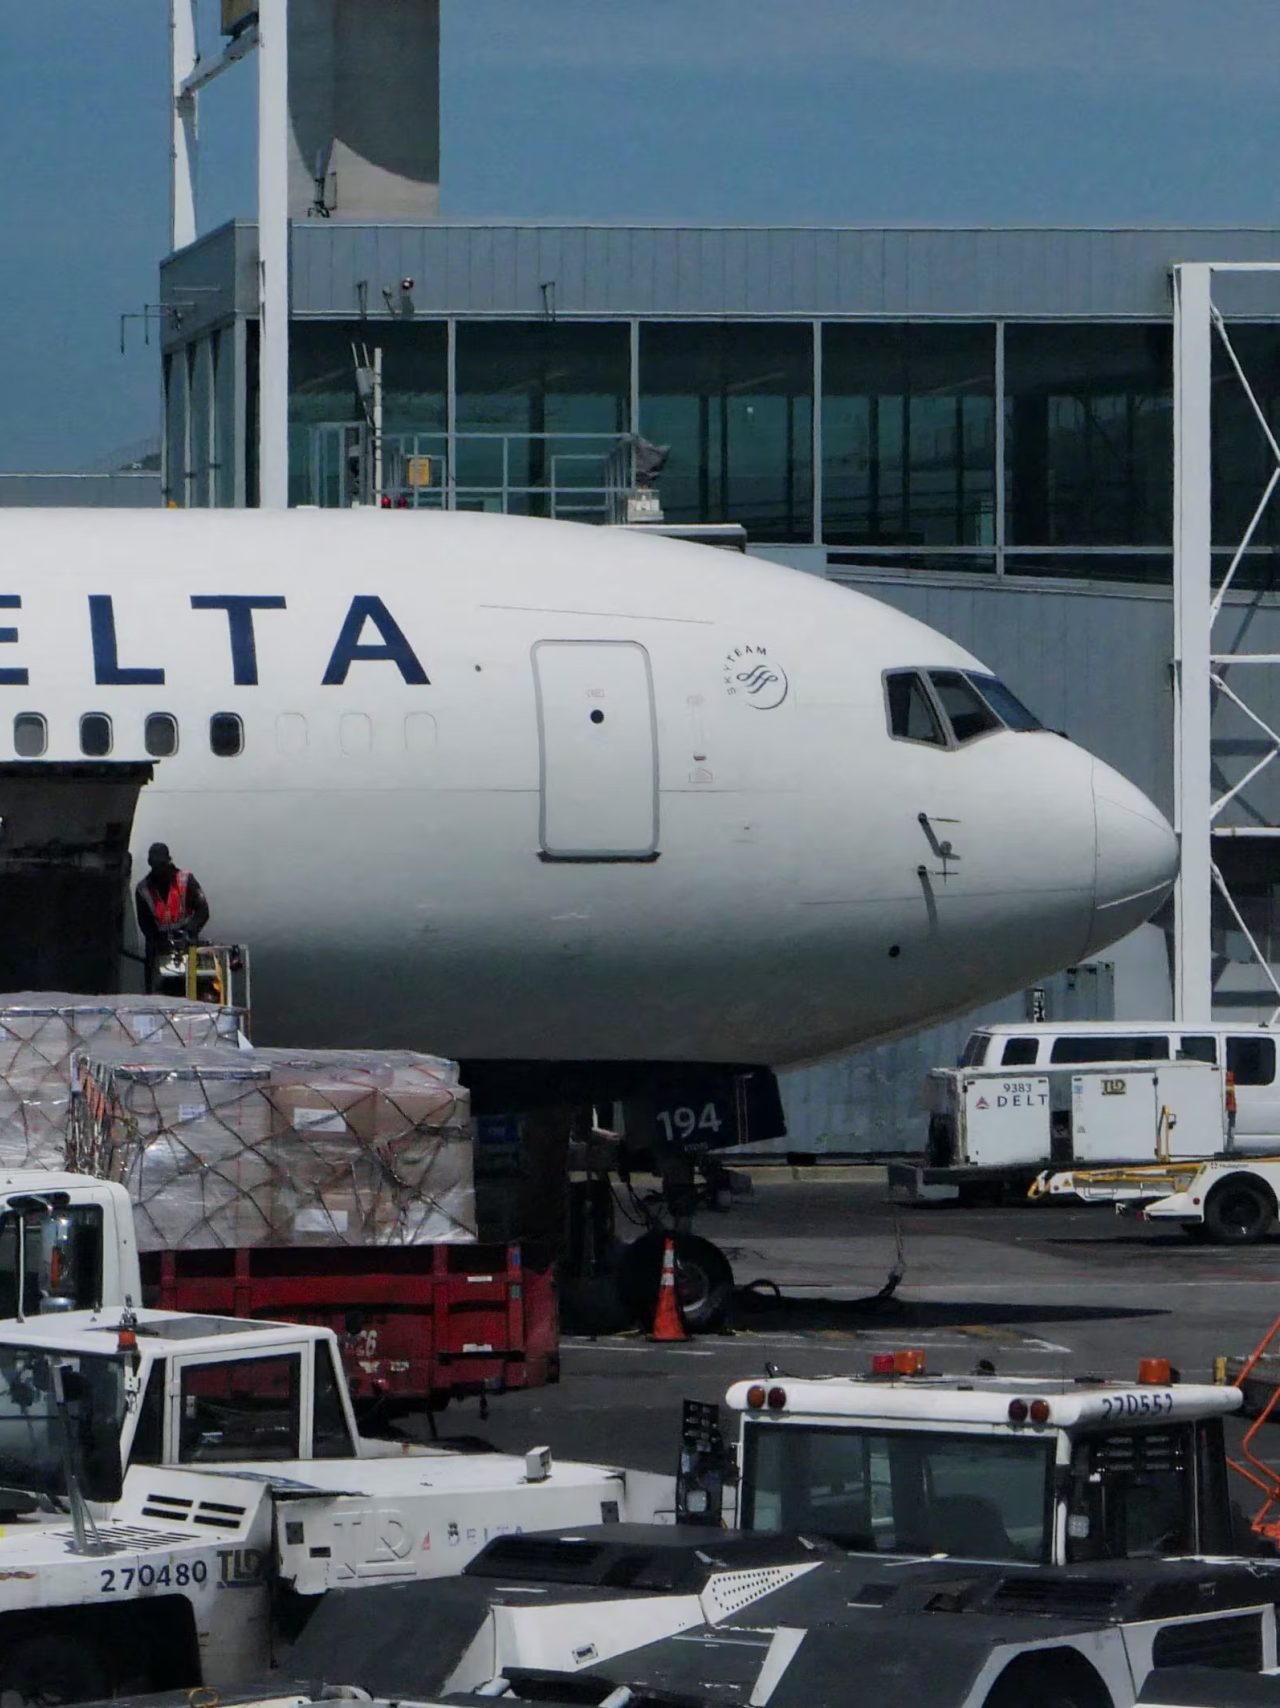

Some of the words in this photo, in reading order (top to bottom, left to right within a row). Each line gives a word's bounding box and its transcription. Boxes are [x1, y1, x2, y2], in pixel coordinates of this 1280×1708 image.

[723, 645, 767, 696] SKYTEAM
[1003, 1083, 1032, 1093] 9383
[1100, 1079, 1126, 1095] TLD
[656, 1102, 722, 1141] 194
[100, 1560, 208, 1593] 270480
[216, 1549, 264, 1589] TLD
